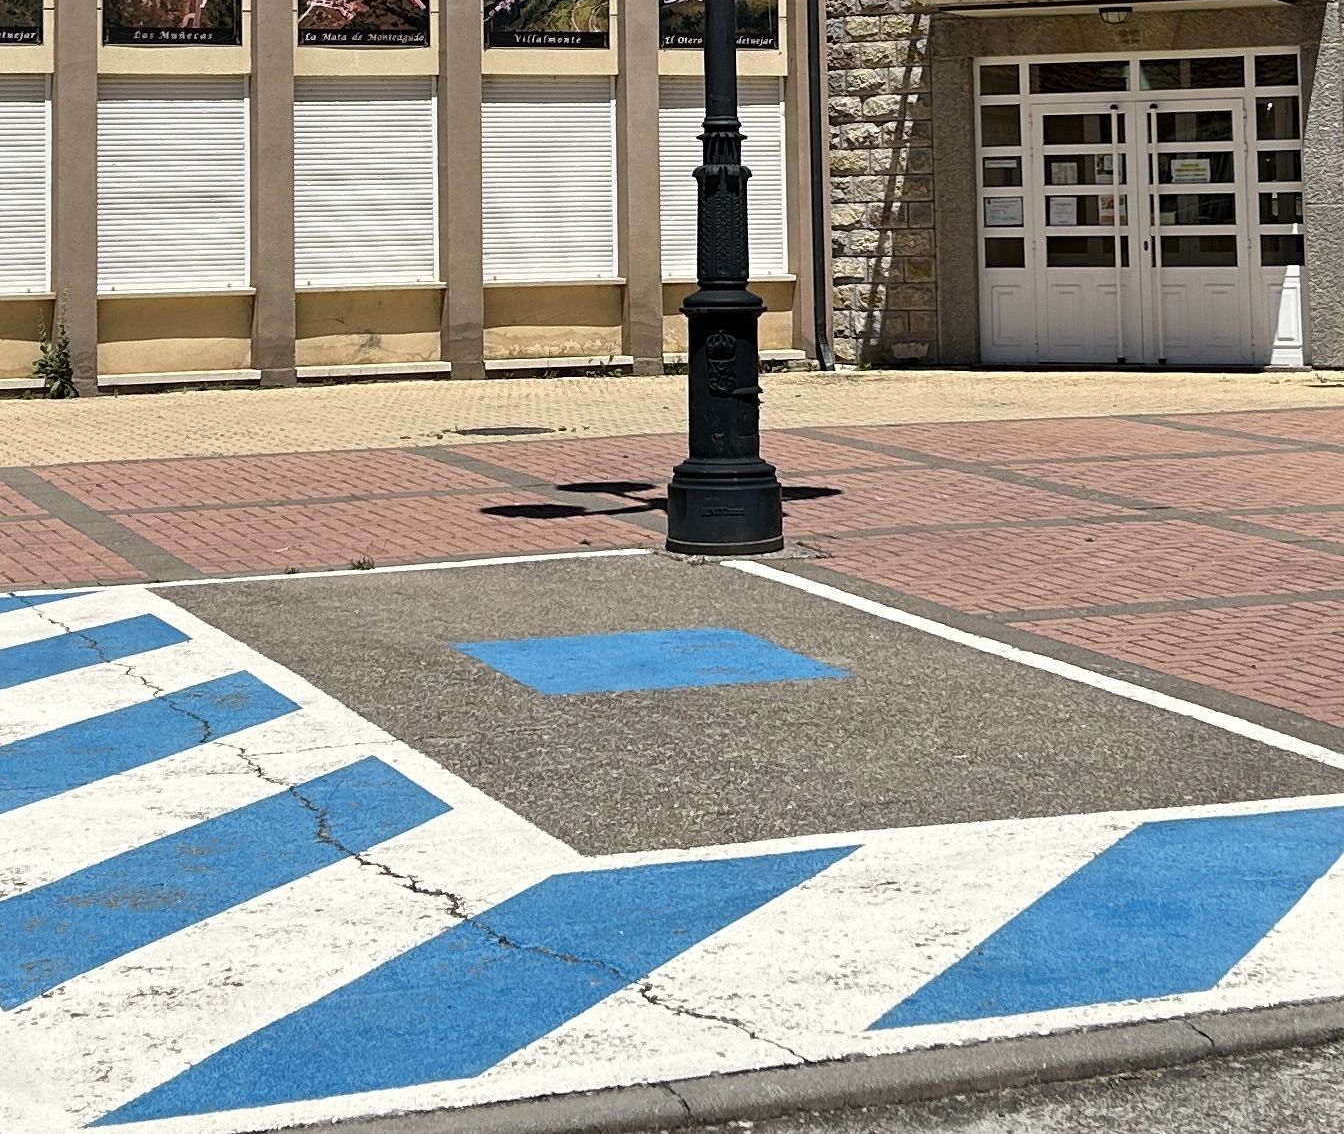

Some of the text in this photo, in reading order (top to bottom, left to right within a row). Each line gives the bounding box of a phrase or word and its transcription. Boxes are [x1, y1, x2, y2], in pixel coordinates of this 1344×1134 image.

[133, 30, 154, 40] Las
[305, 32, 425, 43] La Mata de Monteagudo
[514, 33, 582, 44] Villalmonte
[664, 35, 674, 45] El
[677, 36, 703, 45] Otero
